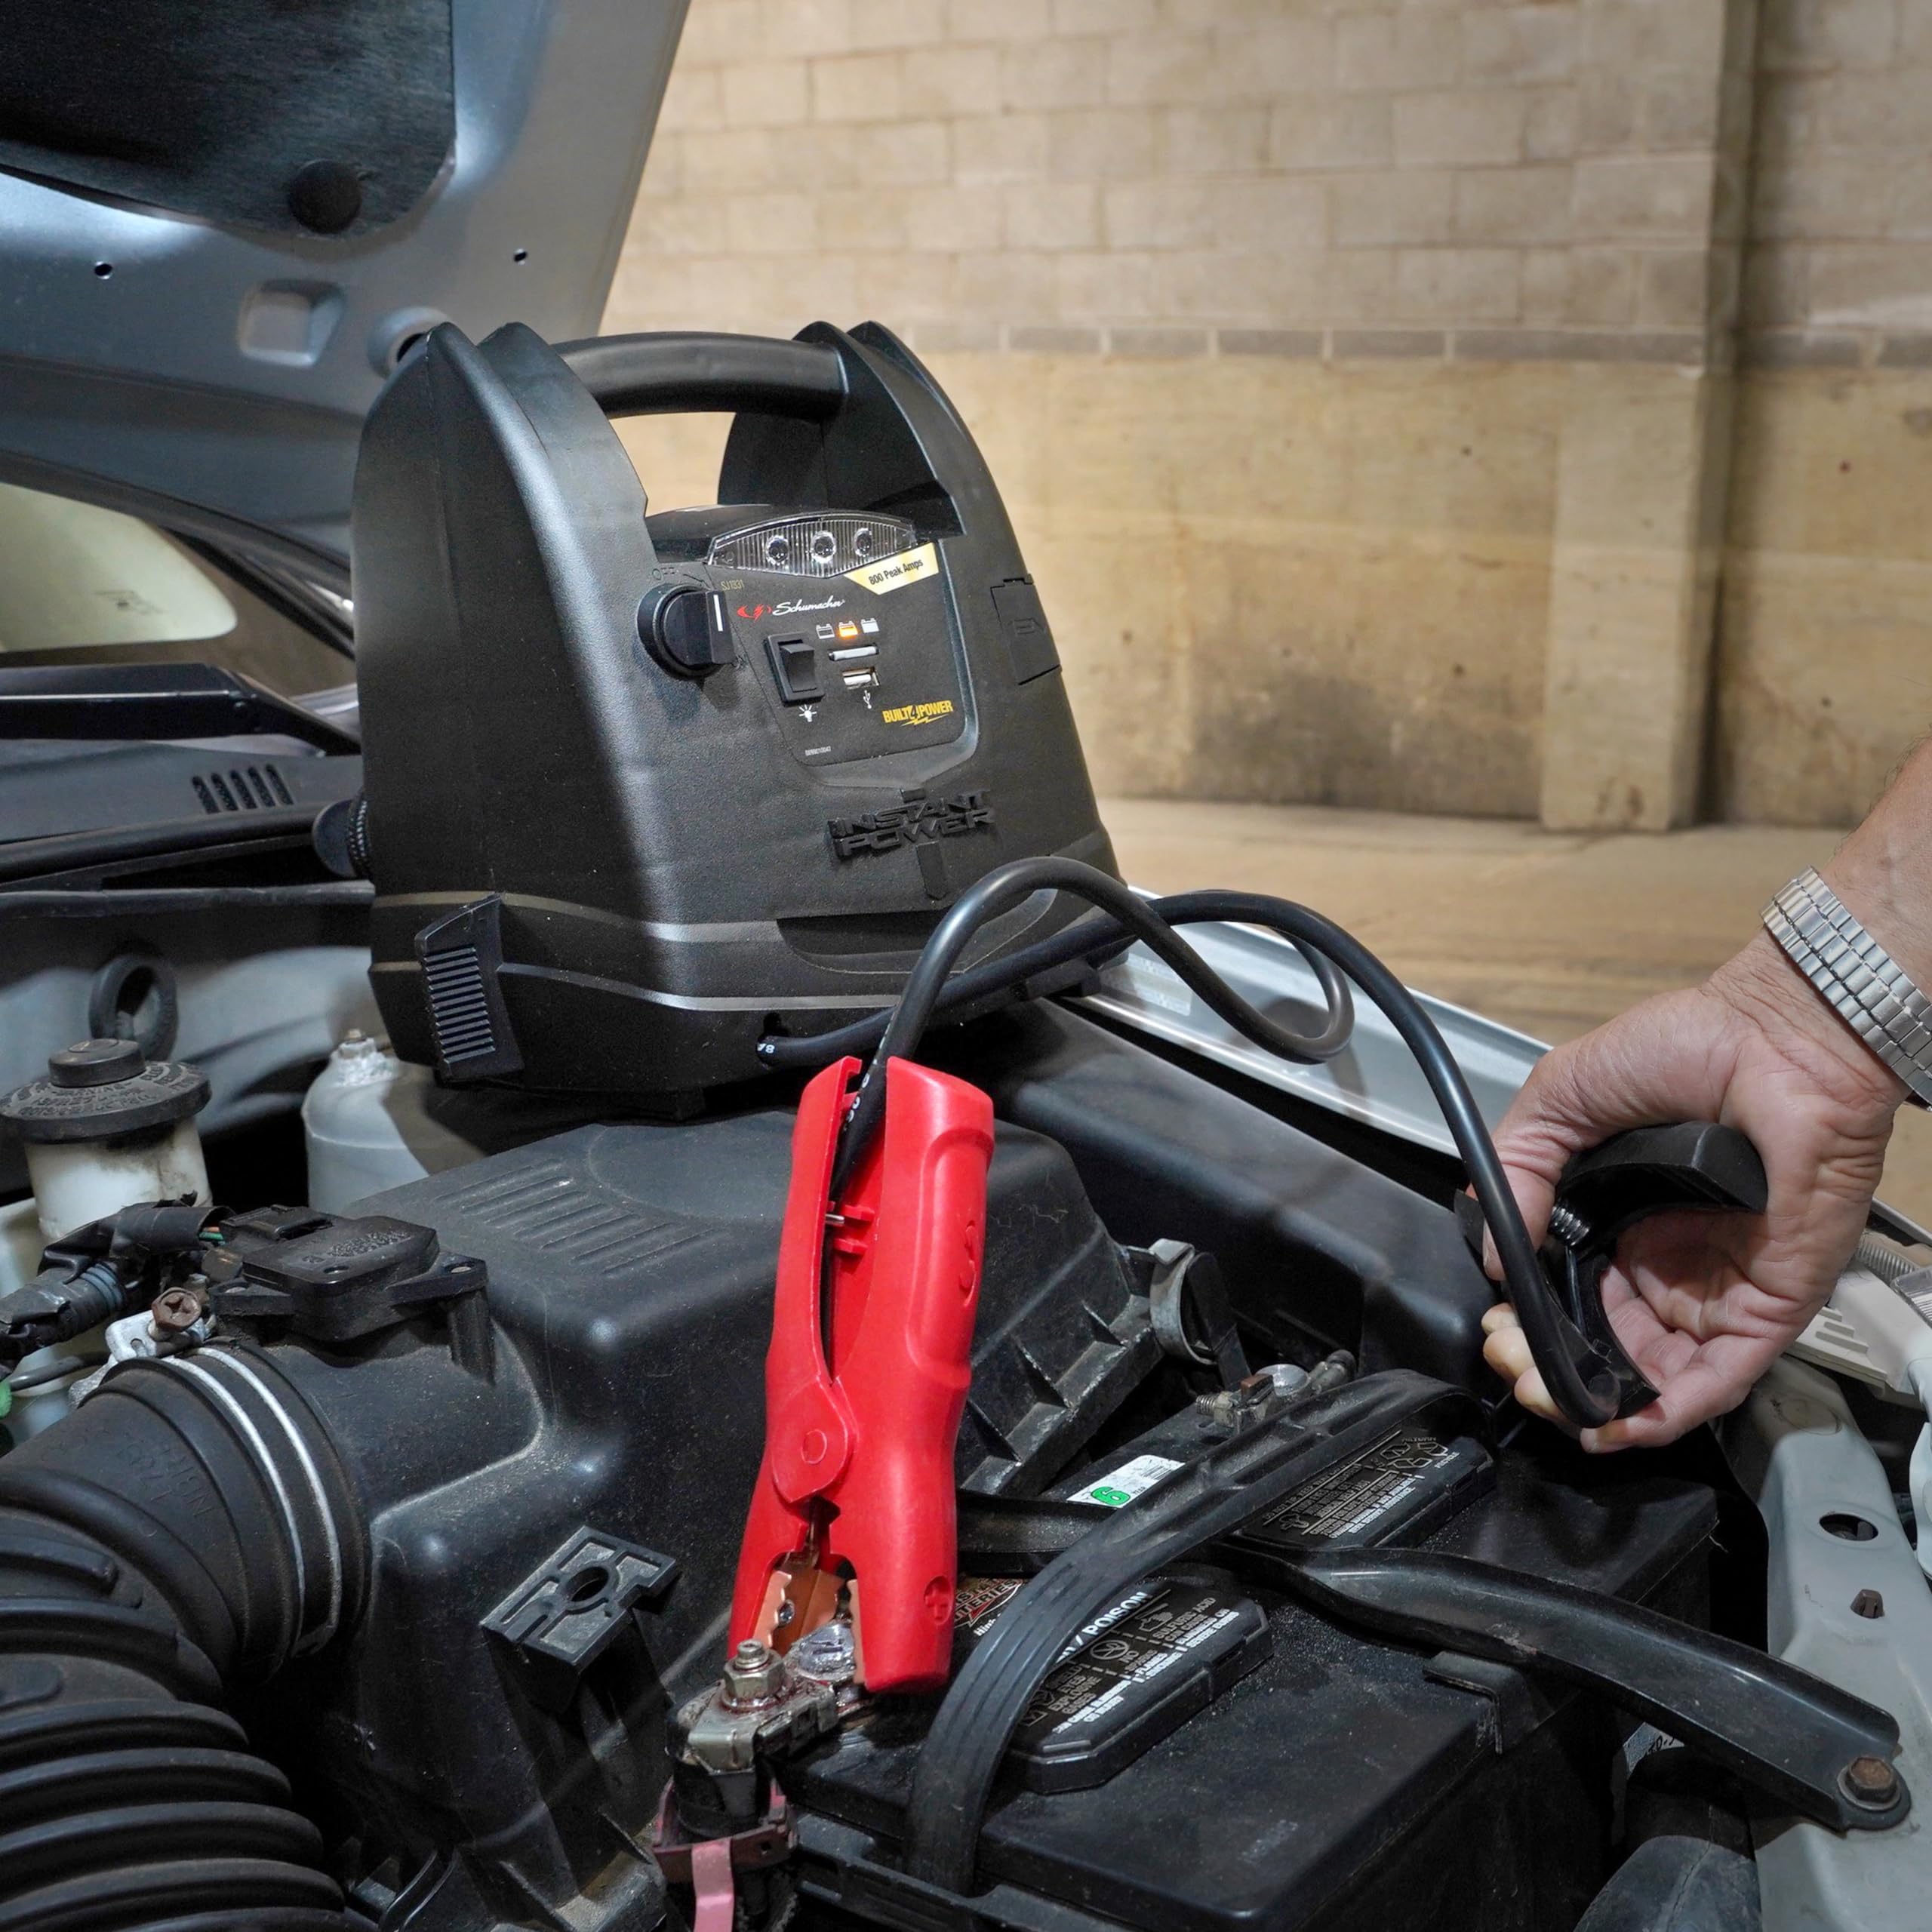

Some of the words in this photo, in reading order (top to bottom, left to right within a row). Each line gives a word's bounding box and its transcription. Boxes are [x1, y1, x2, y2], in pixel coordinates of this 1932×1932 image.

[869, 573, 884, 585] 800
[883, 566, 903, 579] Peak
[903, 559, 924, 571] Amps
[772, 595, 844, 616] Schumacher
[827, 793, 986, 839] INSTANT
[832, 807, 995, 859] POWER
[1091, 1486, 1131, 1506] 6
[1082, 1590, 1152, 1636] POISON
